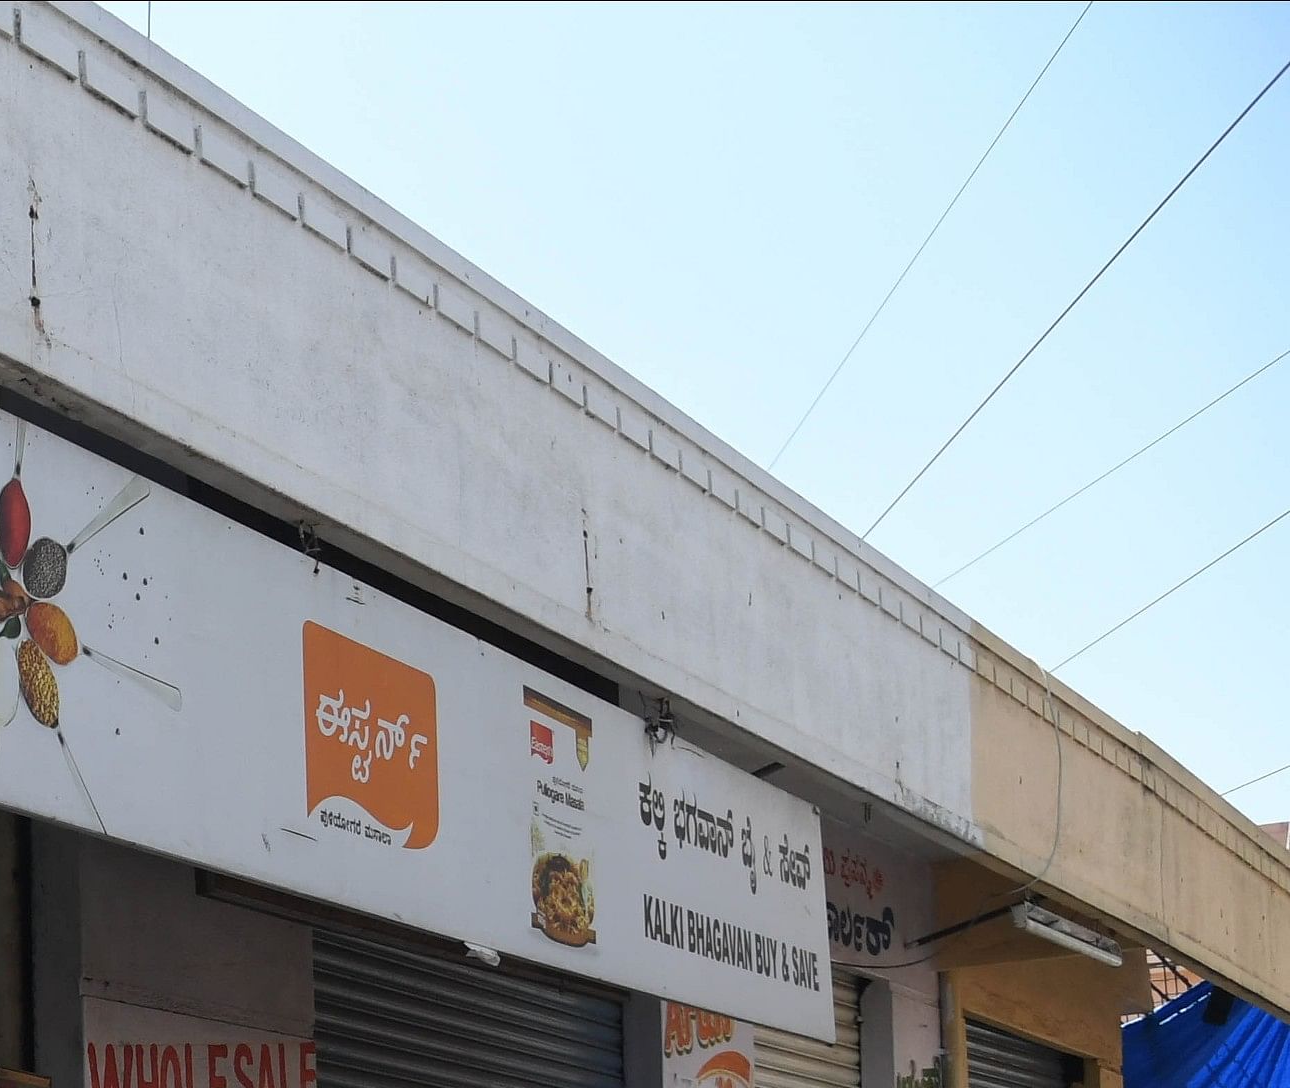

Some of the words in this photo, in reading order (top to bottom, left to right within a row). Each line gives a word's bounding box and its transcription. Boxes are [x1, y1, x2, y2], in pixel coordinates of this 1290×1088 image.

[763, 835, 773, 877] &
[644, 894, 684, 949] KALKI
[687, 909, 753, 972] BHAGAVAN
[755, 933, 778, 979] BUY
[782, 942, 790, 982] &
[793, 947, 820, 992] SAVE
